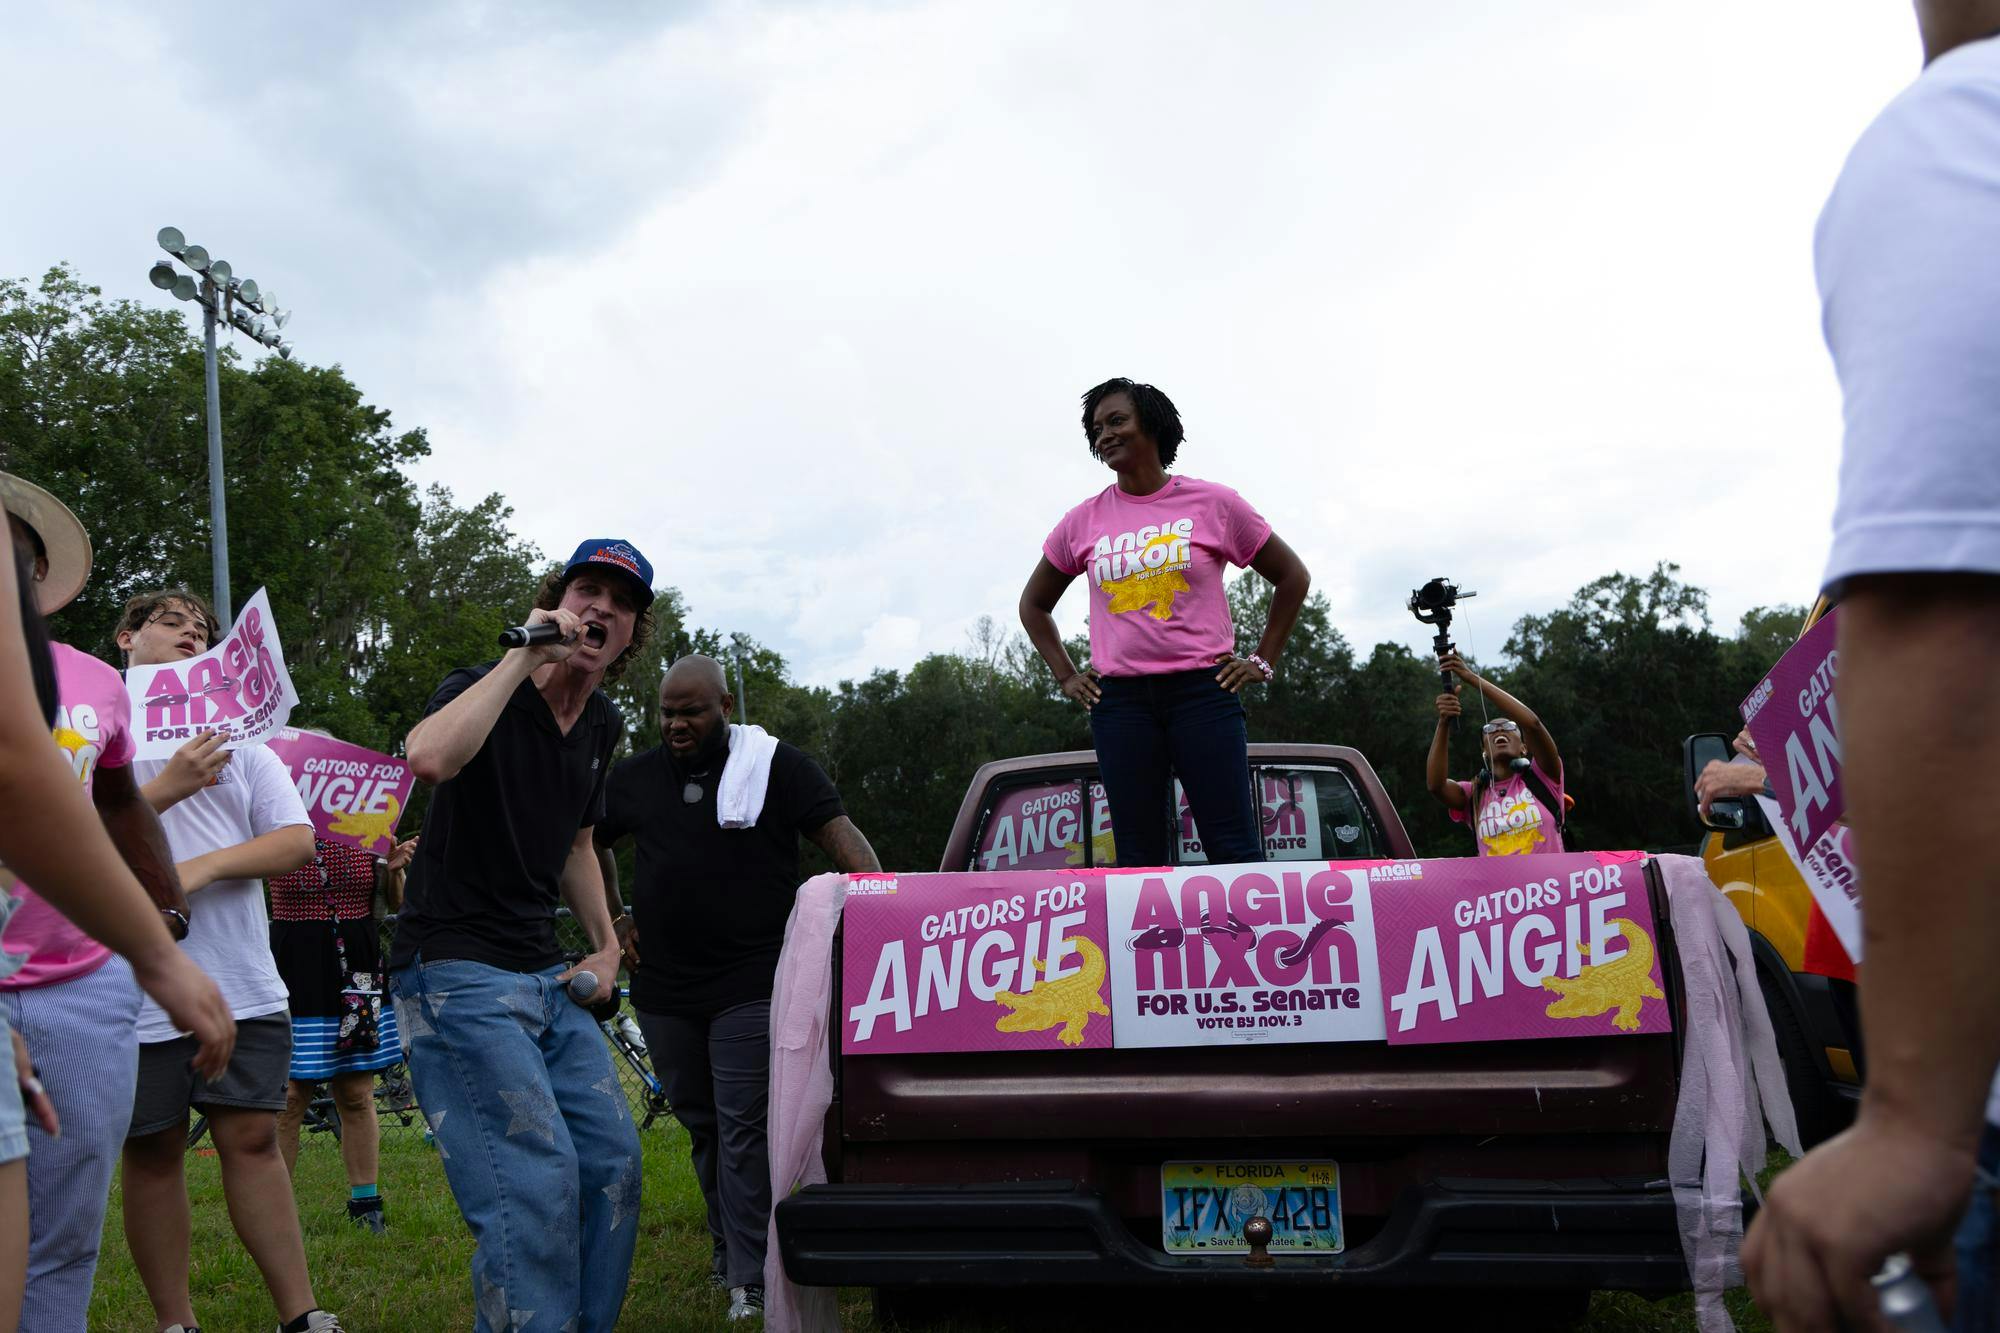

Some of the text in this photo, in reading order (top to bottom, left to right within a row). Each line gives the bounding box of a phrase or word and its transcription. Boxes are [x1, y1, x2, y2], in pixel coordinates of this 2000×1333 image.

[146, 728, 190, 742] FOR
[303, 757, 405, 781] GATORS FOR
[286, 765, 400, 815] NGIE
[1021, 789, 1081, 816] GATORS
[1183, 841, 1204, 854] FO
[1454, 864, 1623, 927] GATORS FOR
[921, 881, 1087, 942] GATORS FOR
[1390, 892, 1626, 1032] ANGIE
[849, 910, 1087, 1042] ANGIE
[1137, 994, 1190, 1017] FOR
[1194, 991, 1246, 1013] U.S.
[1237, 1016, 1256, 1028] BY
[1293, 1014, 1303, 1026] 3
[1215, 1165, 1286, 1178] FLORIDA
[1173, 1187, 1231, 1232] IFX
[1210, 1237, 1234, 1246] Save
[1267, 1237, 1295, 1246] natee
